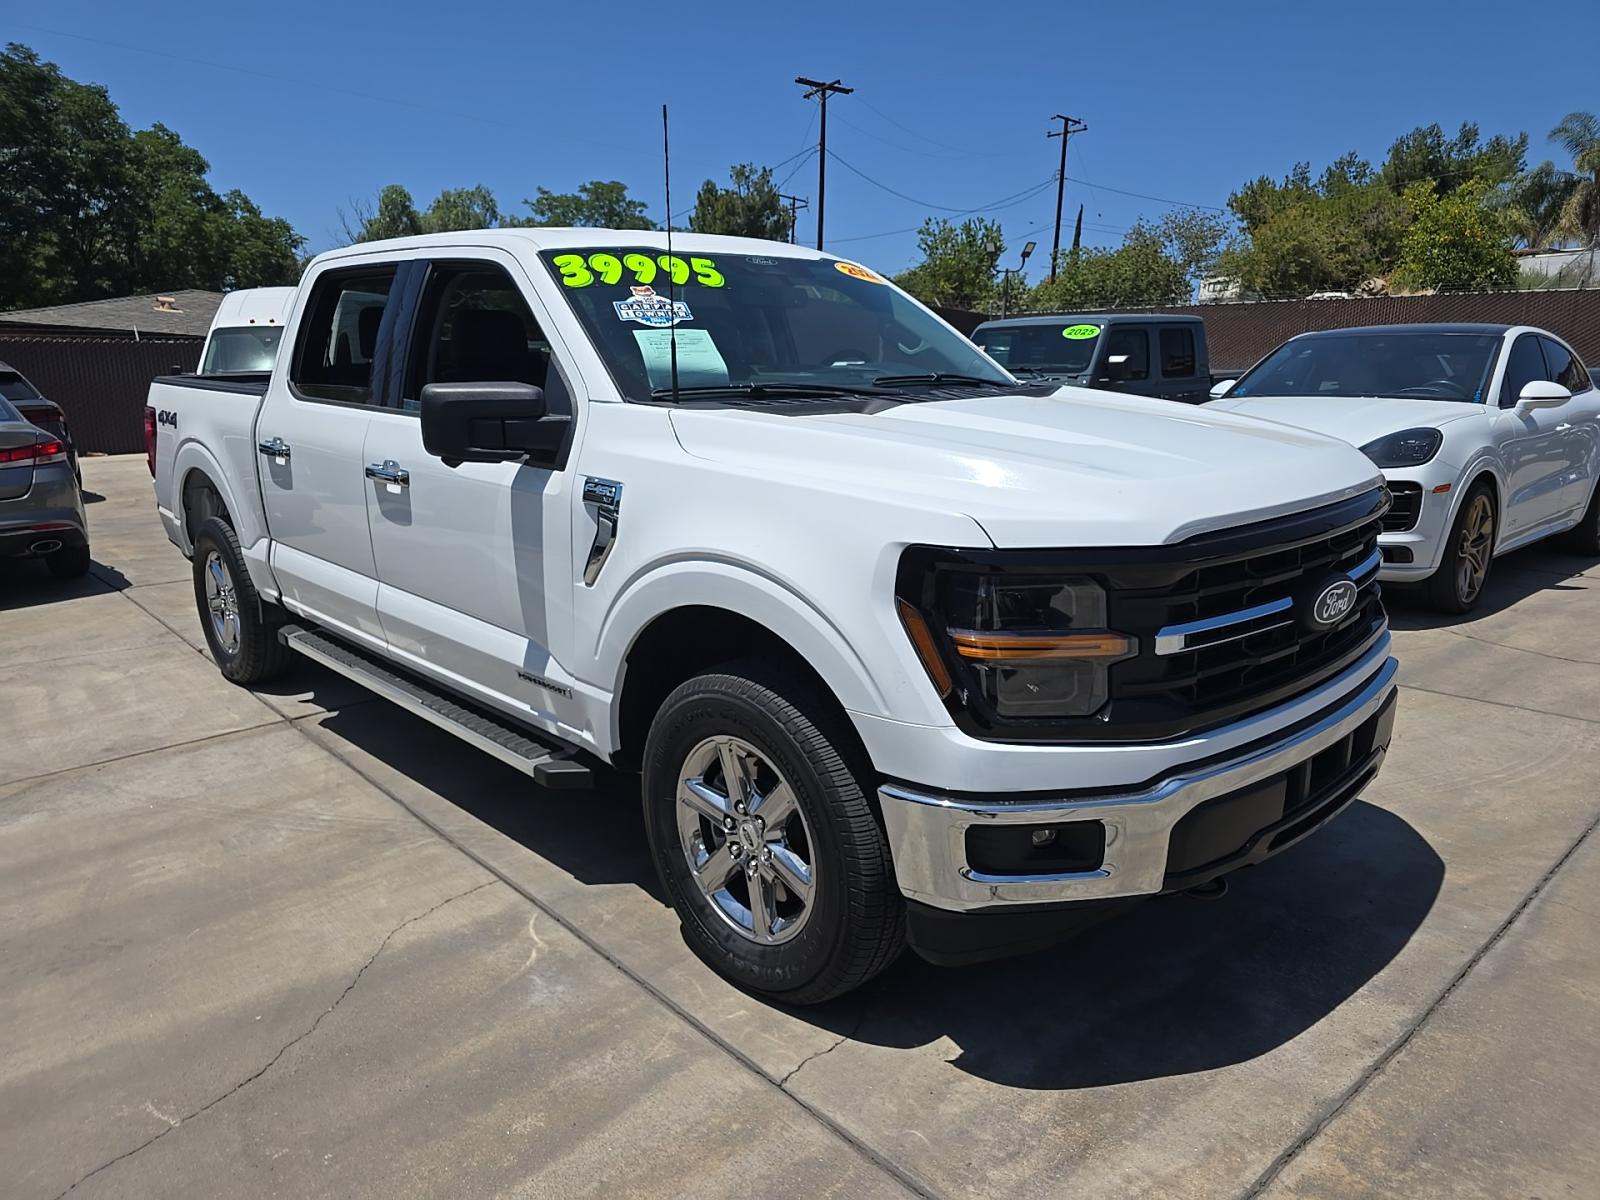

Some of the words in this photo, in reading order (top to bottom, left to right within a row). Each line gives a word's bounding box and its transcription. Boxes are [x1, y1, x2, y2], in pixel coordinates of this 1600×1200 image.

[553, 253, 725, 287] 39995
[620, 303, 686, 311] CARFAX
[1066, 328, 1096, 336] 2025
[585, 483, 615, 498] F-150
[1323, 587, 1350, 618] Ford
